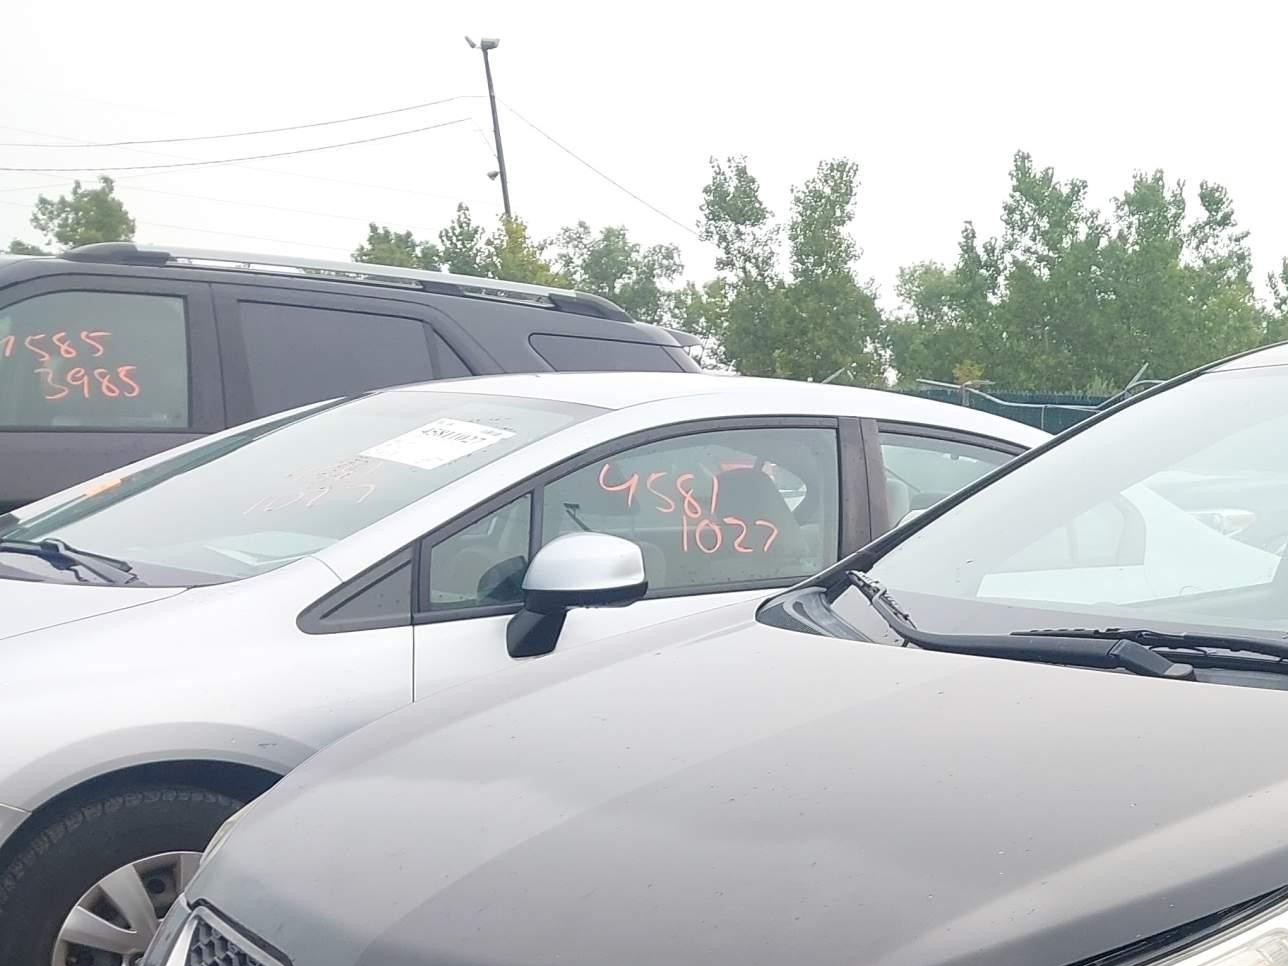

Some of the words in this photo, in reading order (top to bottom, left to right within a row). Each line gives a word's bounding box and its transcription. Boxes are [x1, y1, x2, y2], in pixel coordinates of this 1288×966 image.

[34, 367, 139, 399] 3985
[598, 464, 719, 518] 4581
[682, 514, 779, 553] 1027
